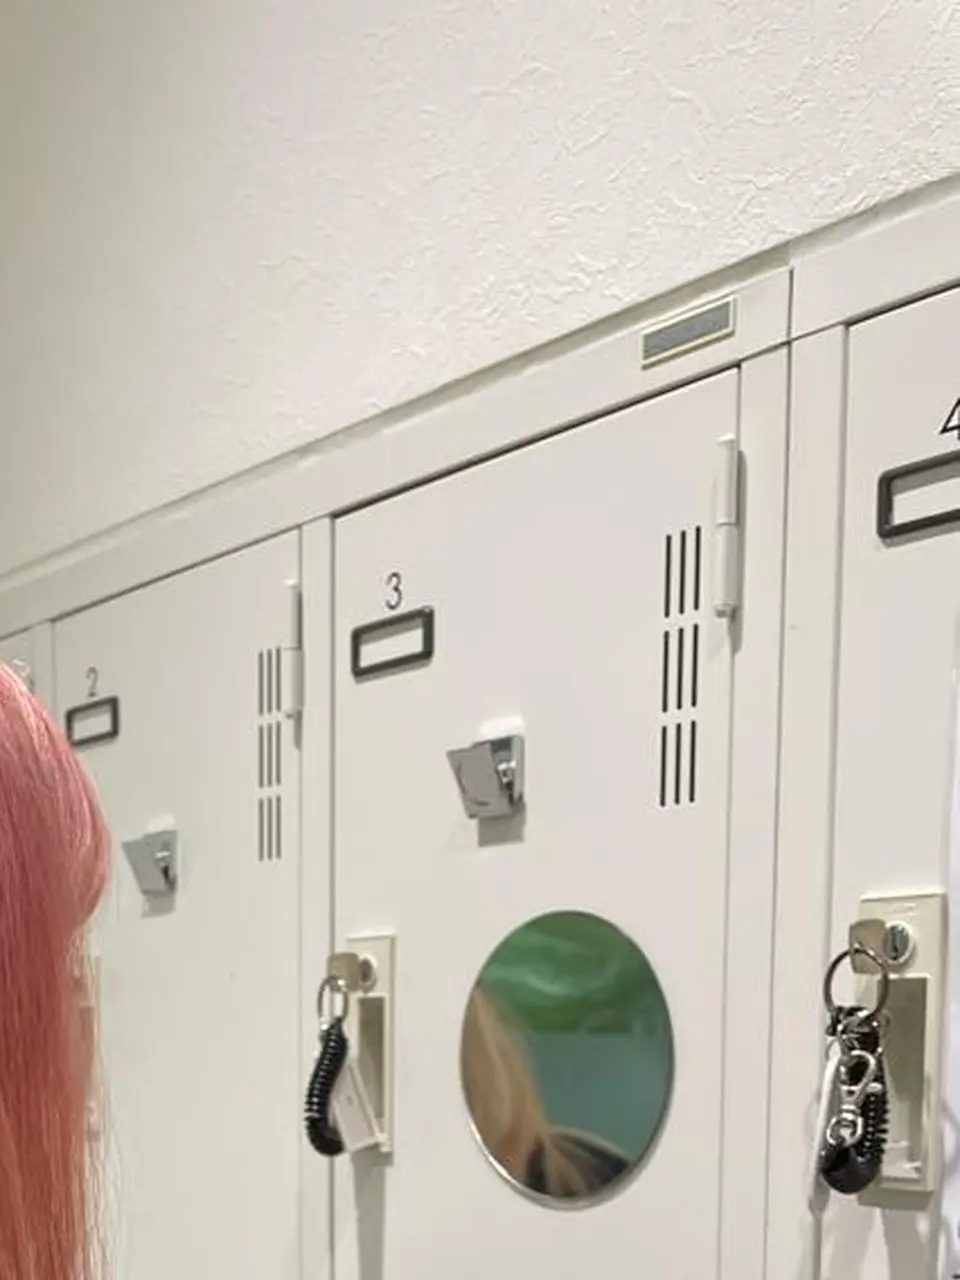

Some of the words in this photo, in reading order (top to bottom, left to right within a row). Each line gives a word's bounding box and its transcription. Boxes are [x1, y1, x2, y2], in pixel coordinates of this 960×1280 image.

[940, 397, 960, 441] 4
[385, 572, 403, 610] 3
[86, 666, 99, 698] 2
